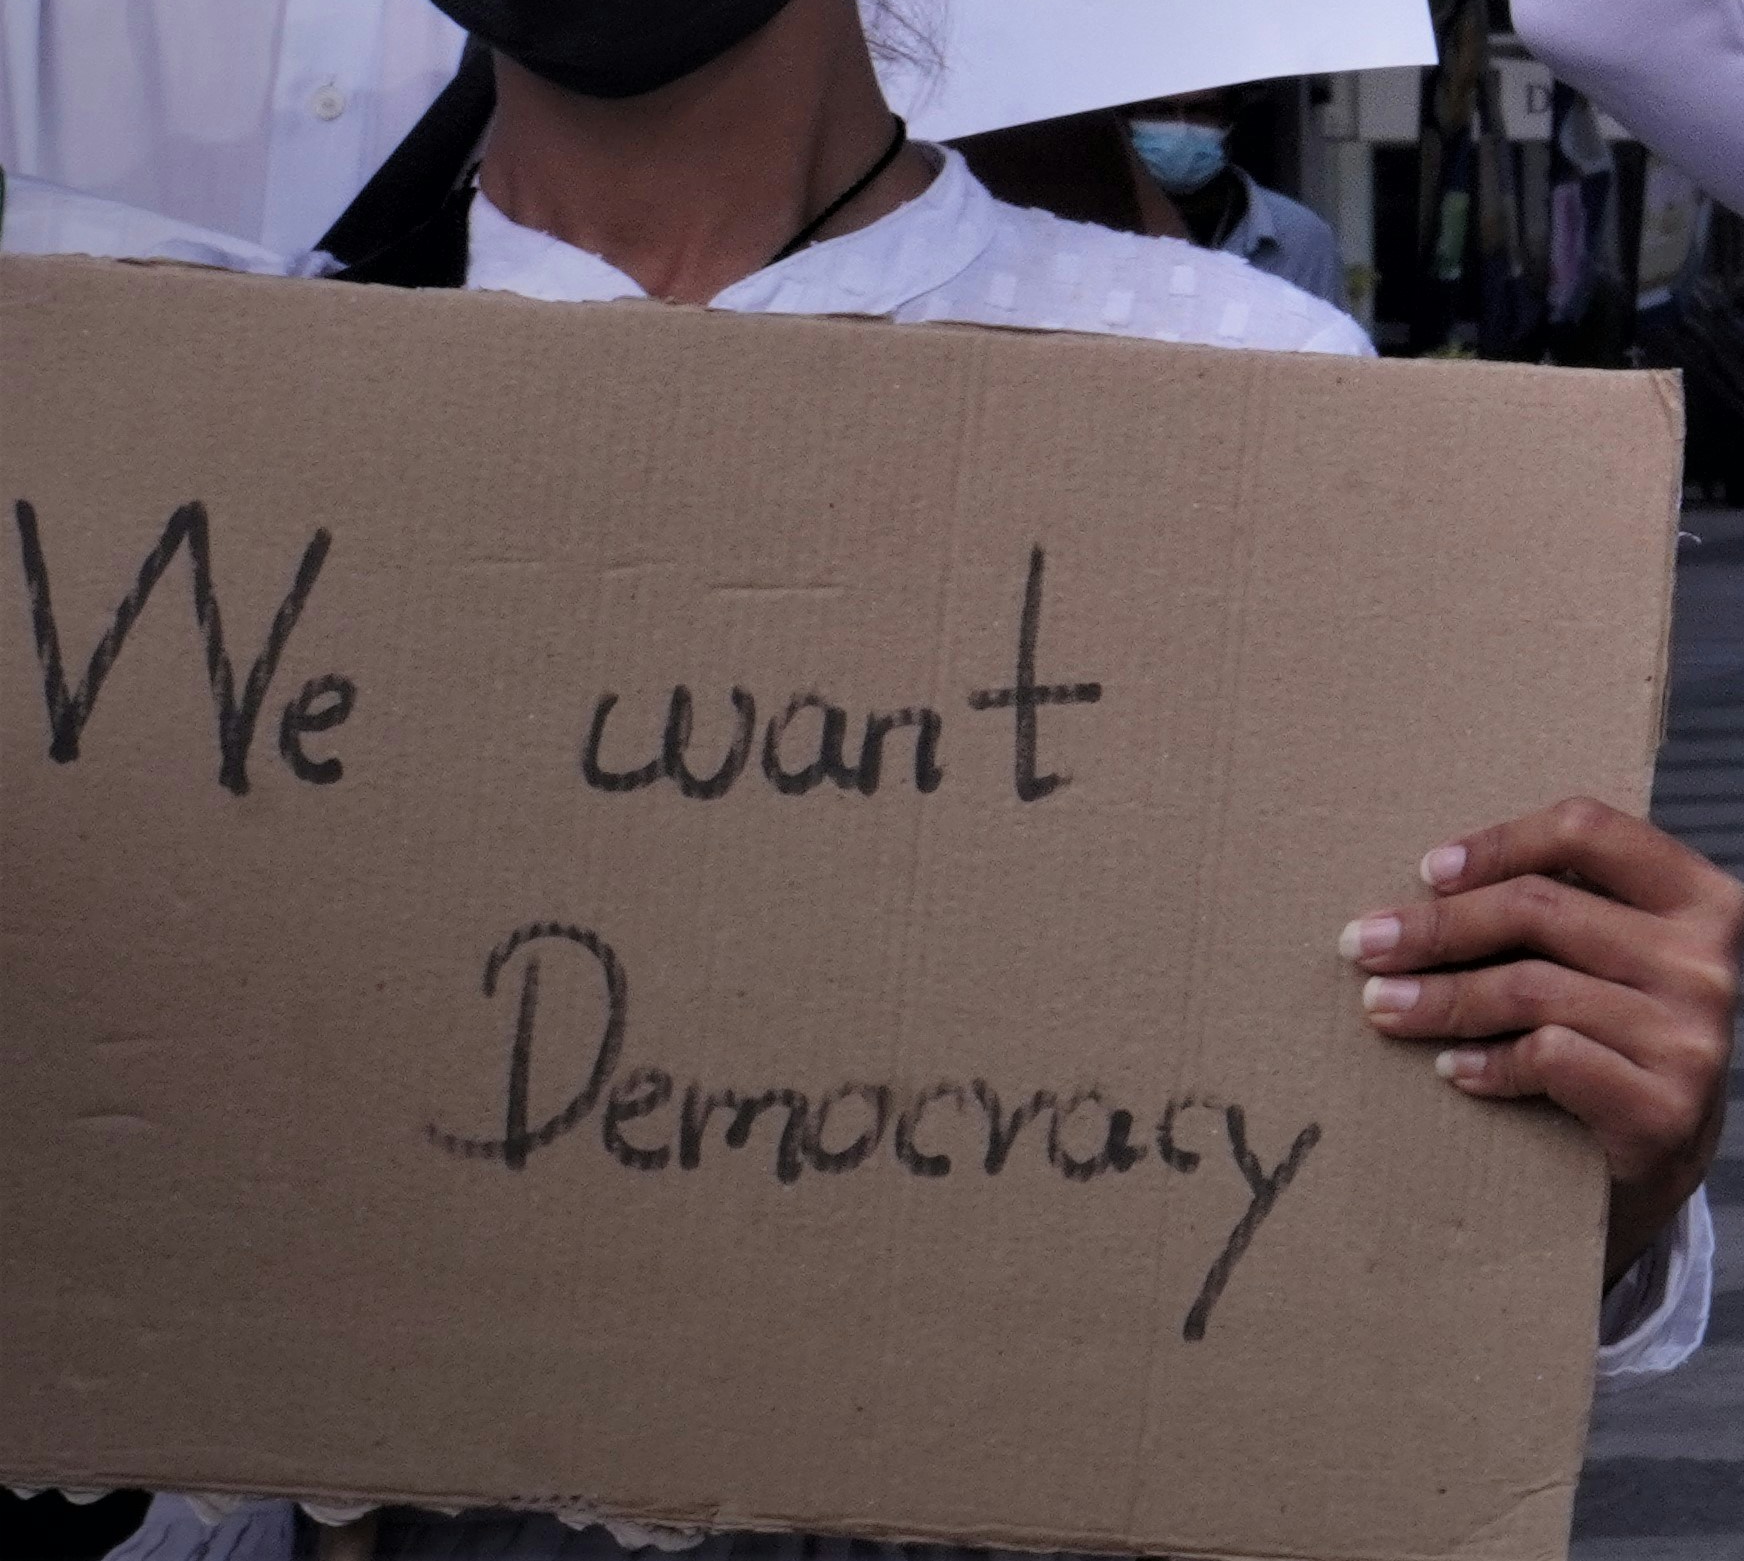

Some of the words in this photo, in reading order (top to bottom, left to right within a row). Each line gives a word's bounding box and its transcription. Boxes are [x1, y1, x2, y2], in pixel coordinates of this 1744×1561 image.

[14, 498, 360, 796] We
[580, 543, 1102, 804] want
[424, 918, 1324, 1342] Democracy
